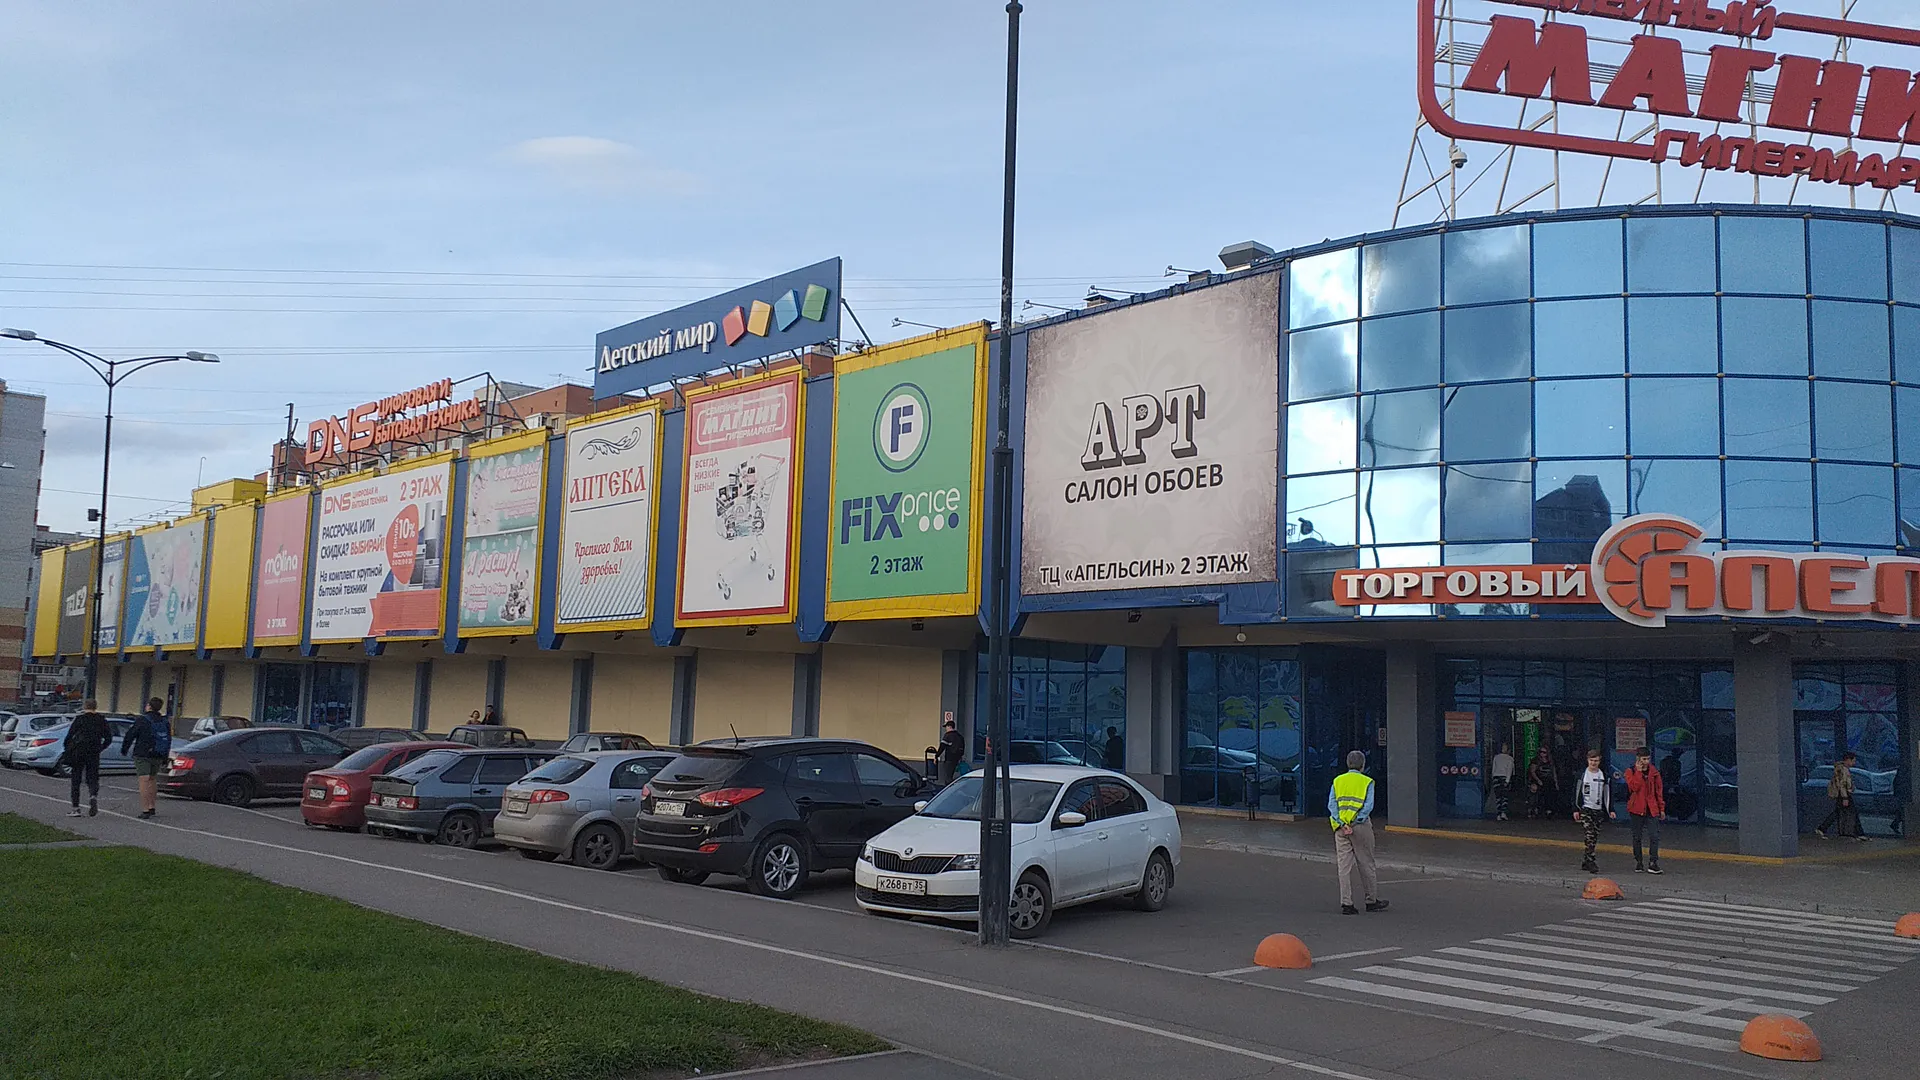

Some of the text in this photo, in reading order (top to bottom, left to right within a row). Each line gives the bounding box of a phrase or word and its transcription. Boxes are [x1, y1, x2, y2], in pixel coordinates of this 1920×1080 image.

[598, 320, 717, 374] Детский мир
[378, 377, 452, 418] ЦИФРОВАЯ И
[374, 397, 481, 445] БЫТОВАЯ ТЕХНИКА
[702, 403, 781, 435] МАГНИТ
[725, 424, 776, 441] ГИПЕРМАРКЕТ
[1081, 384, 1206, 471] АРТ
[306, 402, 378, 465] DNS
[694, 468, 720, 480] НИЗКИЕ
[695, 457, 719, 469] ВСЕГДА
[400, 474, 443, 502] 2 ЭТАЖ
[569, 465, 647, 503] АПТЕКА
[1064, 463, 1224, 504] САЛОН ОБОЕВ
[324, 491, 352, 515] DNS
[901, 487, 961, 524] price
[322, 518, 376, 540] РАССРОЧКА ИЛИ
[320, 542, 349, 560] СКИДКА?
[574, 536, 633, 564] Крепкого Вам
[320, 570, 328, 582] На
[329, 569, 356, 581] комплект
[356, 563, 383, 582] крупной
[580, 558, 623, 585] здоровья!
[870, 555, 924, 575] 2 этаж
[1040, 553, 1249, 587] ТЦ «АПЕЛЬСИН» 2 ЭТАЖ
[318, 582, 368, 597] бытовой техники
[1340, 563, 1587, 600] ТОРГОВЫЙ
